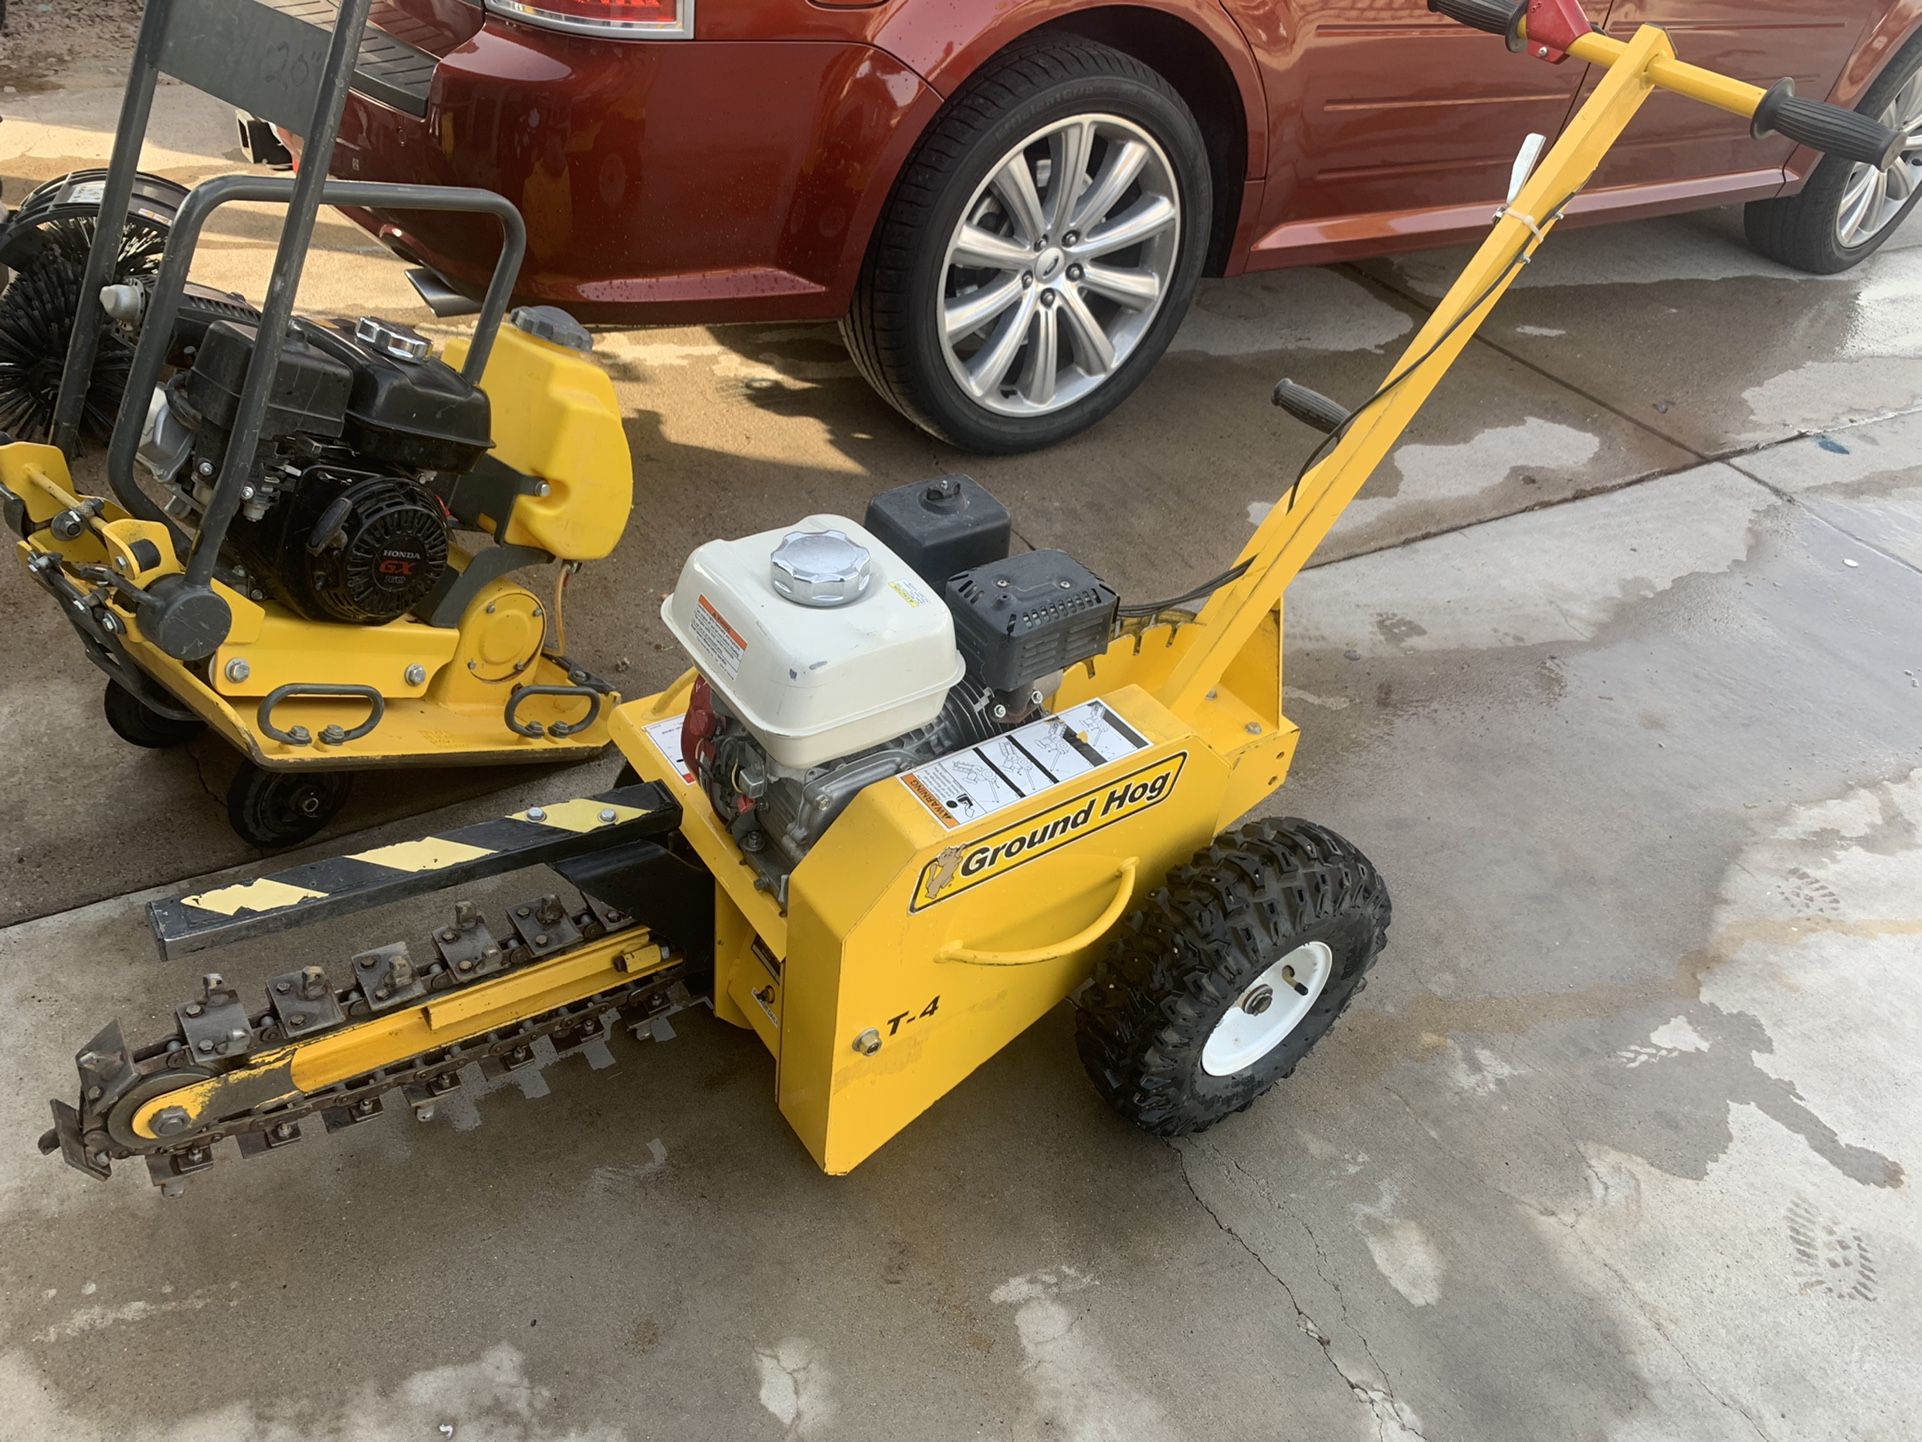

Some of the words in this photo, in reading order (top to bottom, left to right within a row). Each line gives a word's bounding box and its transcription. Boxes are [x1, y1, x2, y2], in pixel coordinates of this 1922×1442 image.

[379, 560, 416, 576] GX
[383, 549, 421, 560] HONDA
[910, 779, 943, 816] WARNING
[961, 798, 1096, 876] Ground
[1101, 772, 1171, 817] Hog
[886, 995, 940, 1036] T-4
